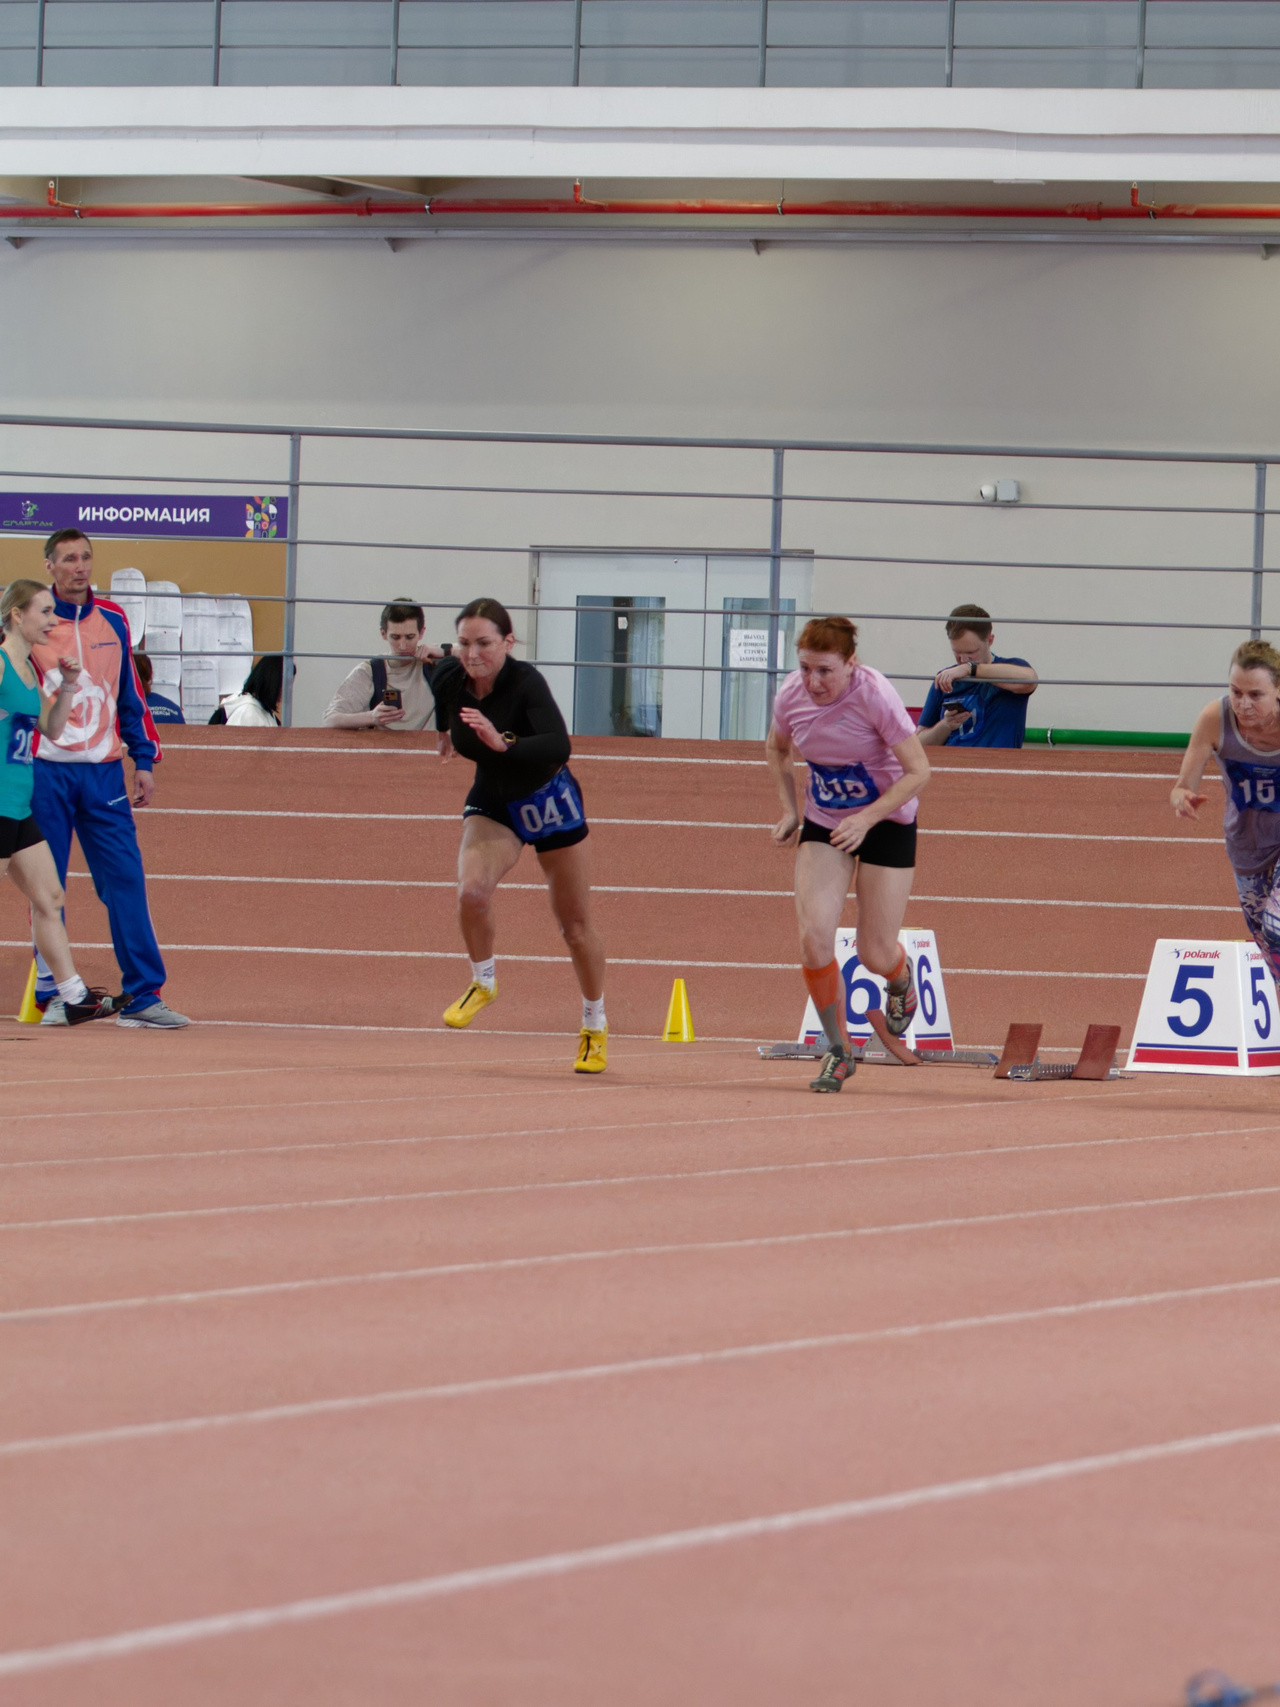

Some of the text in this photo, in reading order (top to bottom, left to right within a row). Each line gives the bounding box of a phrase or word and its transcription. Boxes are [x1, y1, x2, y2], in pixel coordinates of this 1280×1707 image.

[78, 506, 210, 525] ИНФОРМАЦИЯ
[520, 787, 581, 833] 041
[841, 954, 882, 1025] 6
[917, 954, 937, 1026] 6
[1183, 949, 1221, 960] polanik
[1166, 964, 1214, 1038] 5
[1250, 966, 1271, 1040] 5
